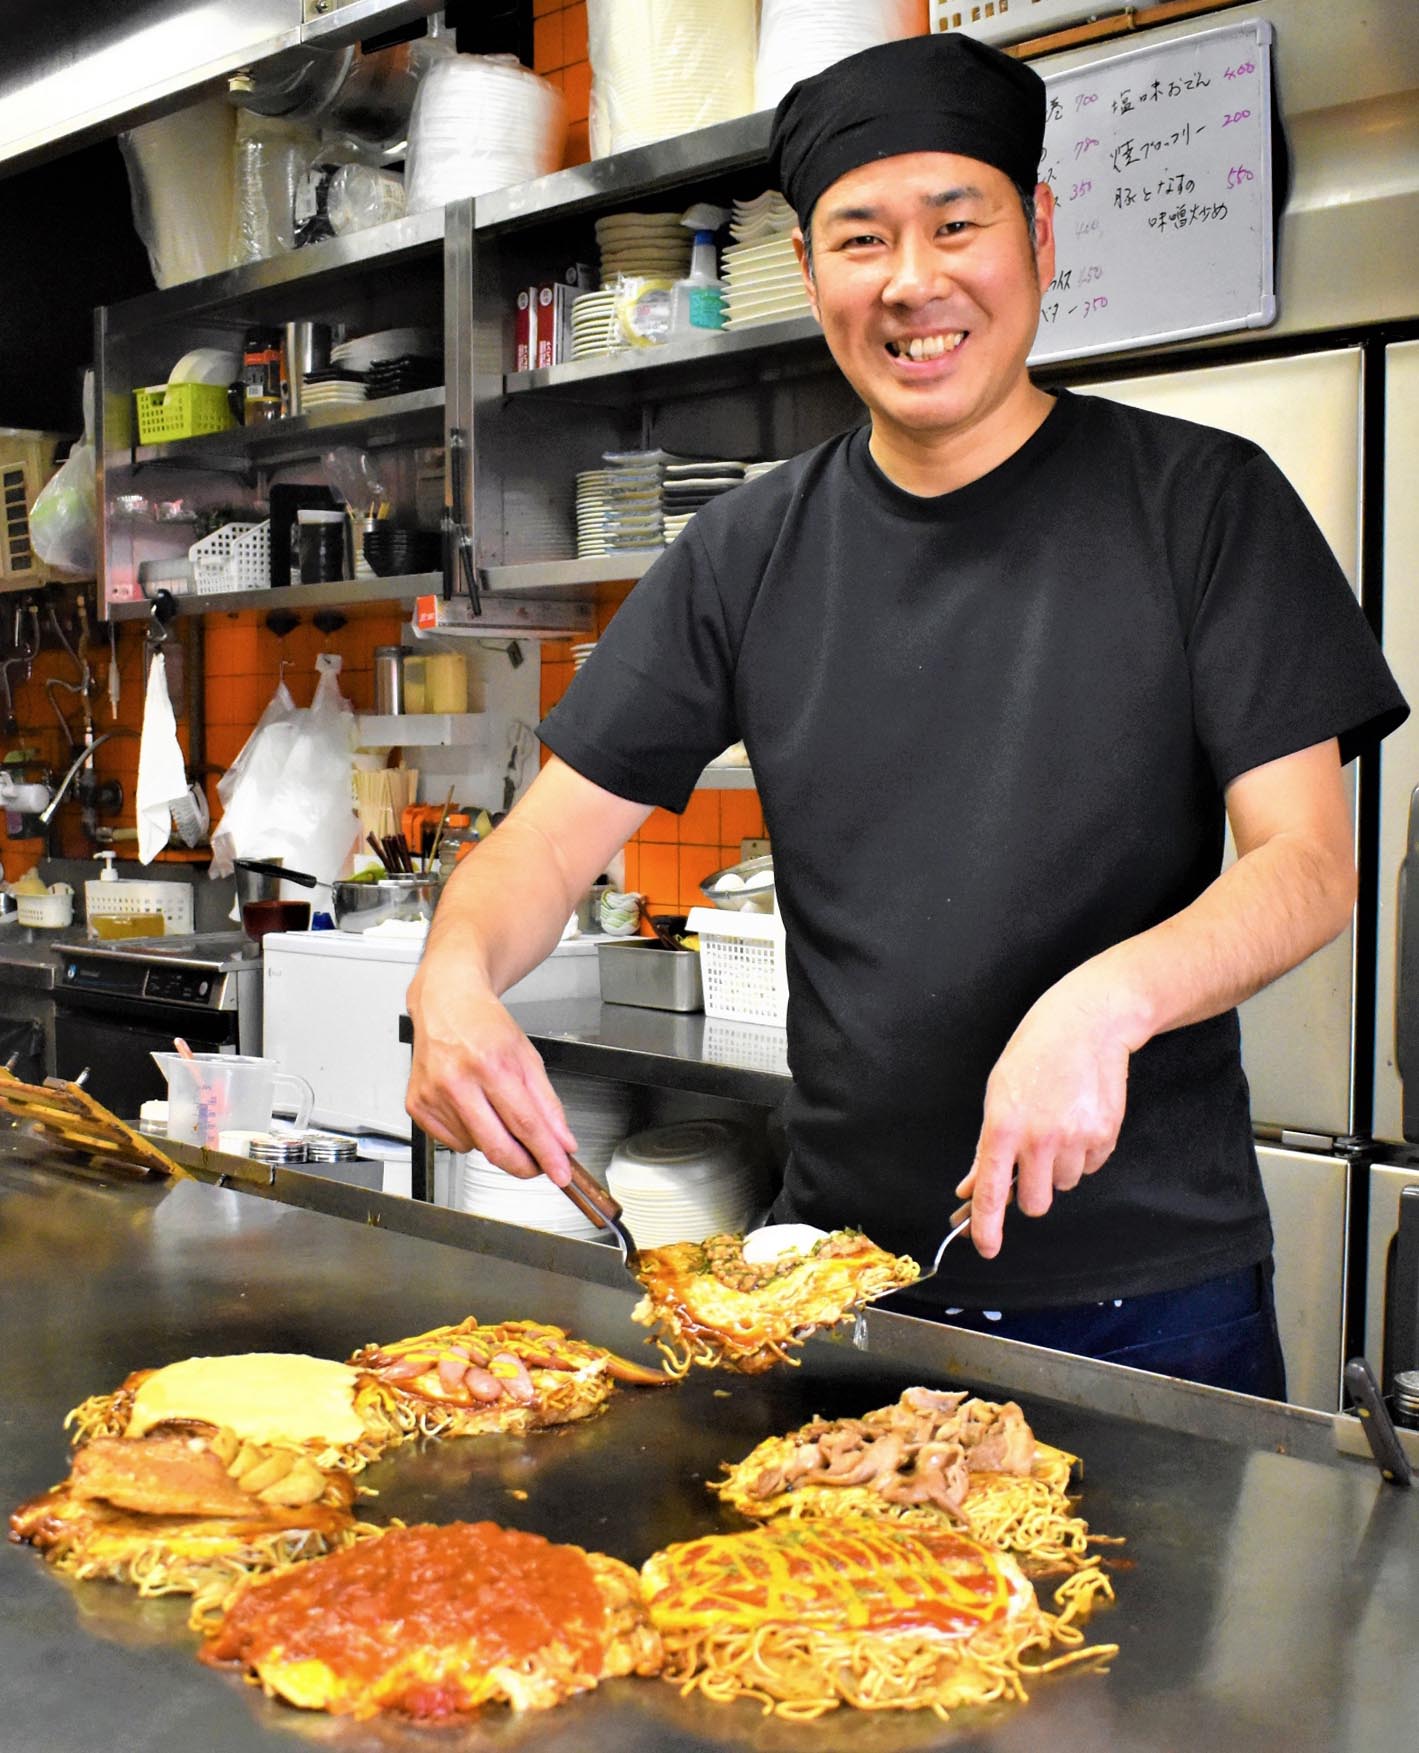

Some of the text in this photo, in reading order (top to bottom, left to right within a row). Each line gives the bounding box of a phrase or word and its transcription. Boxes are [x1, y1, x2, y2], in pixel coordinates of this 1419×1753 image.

[1223, 61, 1255, 80] 400
[1075, 93, 1098, 112] 700
[1221, 110, 1251, 127] 200
[1226, 164, 1254, 190] 550
[1083, 296, 1109, 319] 350
